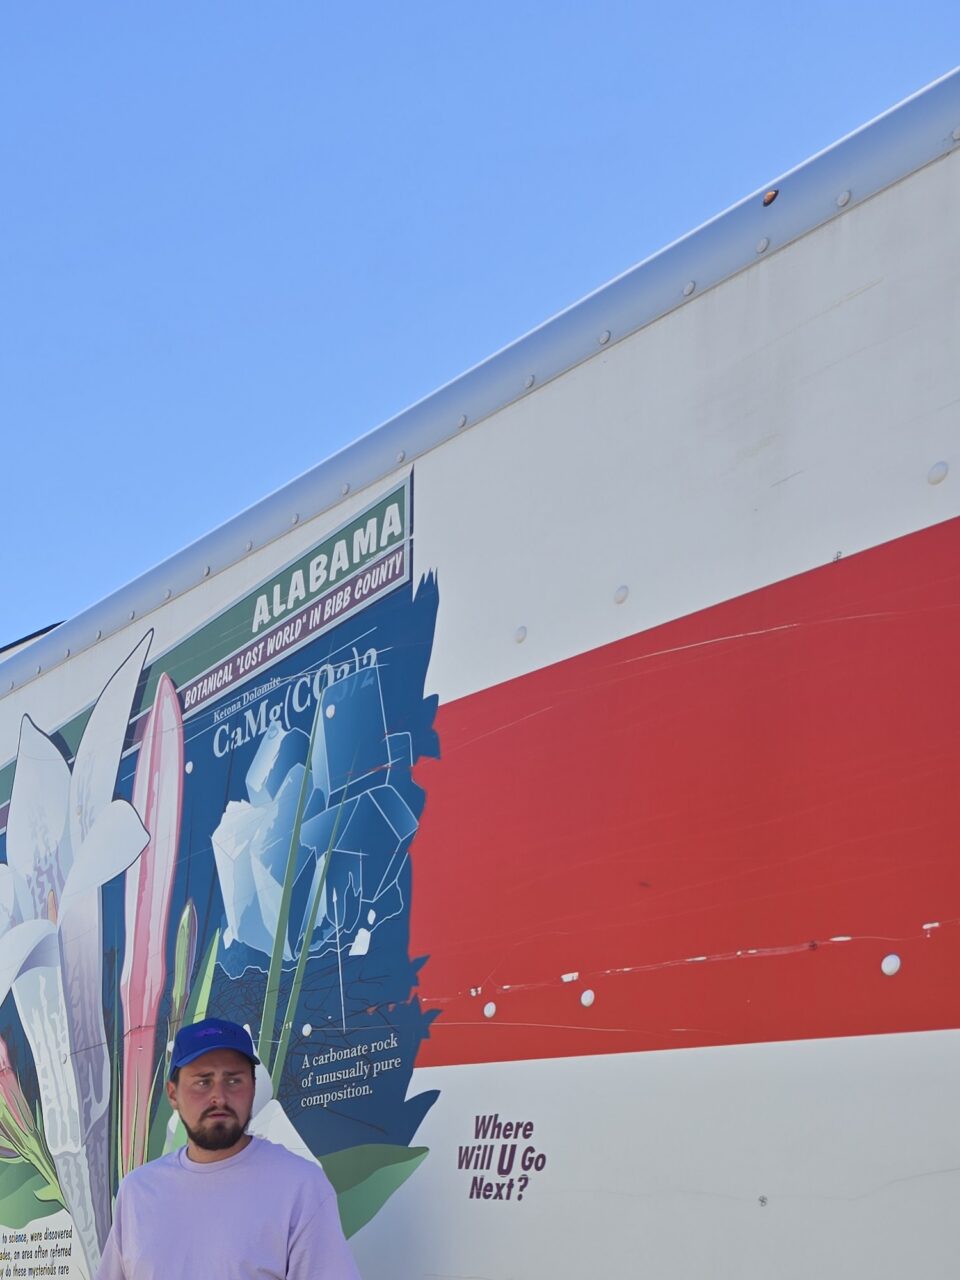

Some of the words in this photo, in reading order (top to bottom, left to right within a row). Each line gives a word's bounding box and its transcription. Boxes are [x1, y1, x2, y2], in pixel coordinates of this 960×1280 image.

[252, 502, 402, 633] ALABAMA
[184, 665, 233, 709] BOTANICAL
[236, 653, 264, 674] "LOST
[266, 614, 306, 657] WORLD"
[309, 609, 321, 630] IN
[324, 589, 351, 621] BIBB
[354, 551, 403, 599] COUNTY
[213, 701, 241, 723] Ketona
[242, 676, 282, 706] Dolomite
[301, 1054, 311, 1069] A
[312, 1043, 368, 1066] carbonate
[371, 1033, 398, 1054] rock
[301, 1072, 314, 1088] of
[316, 1061, 371, 1086] unusually
[373, 1057, 402, 1077] pure
[301, 1083, 373, 1108] composition.
[474, 1113, 534, 1140] Where
[457, 1145, 494, 1170] Will
[497, 1144, 516, 1176] U
[521, 1147, 546, 1172] Go
[30, 1232, 42, 1241] were
[44, 1225, 72, 1240] discovered
[14, 1251, 20, 1260] an
[22, 1250, 33, 1259] area
[35, 1245, 48, 1258] often
[50, 1243, 72, 1258] referred
[6, 1264, 11, 1277] do
[13, 1263, 26, 1277] these
[28, 1263, 56, 1278] mysterious
[58, 1265, 69, 1275] rare
